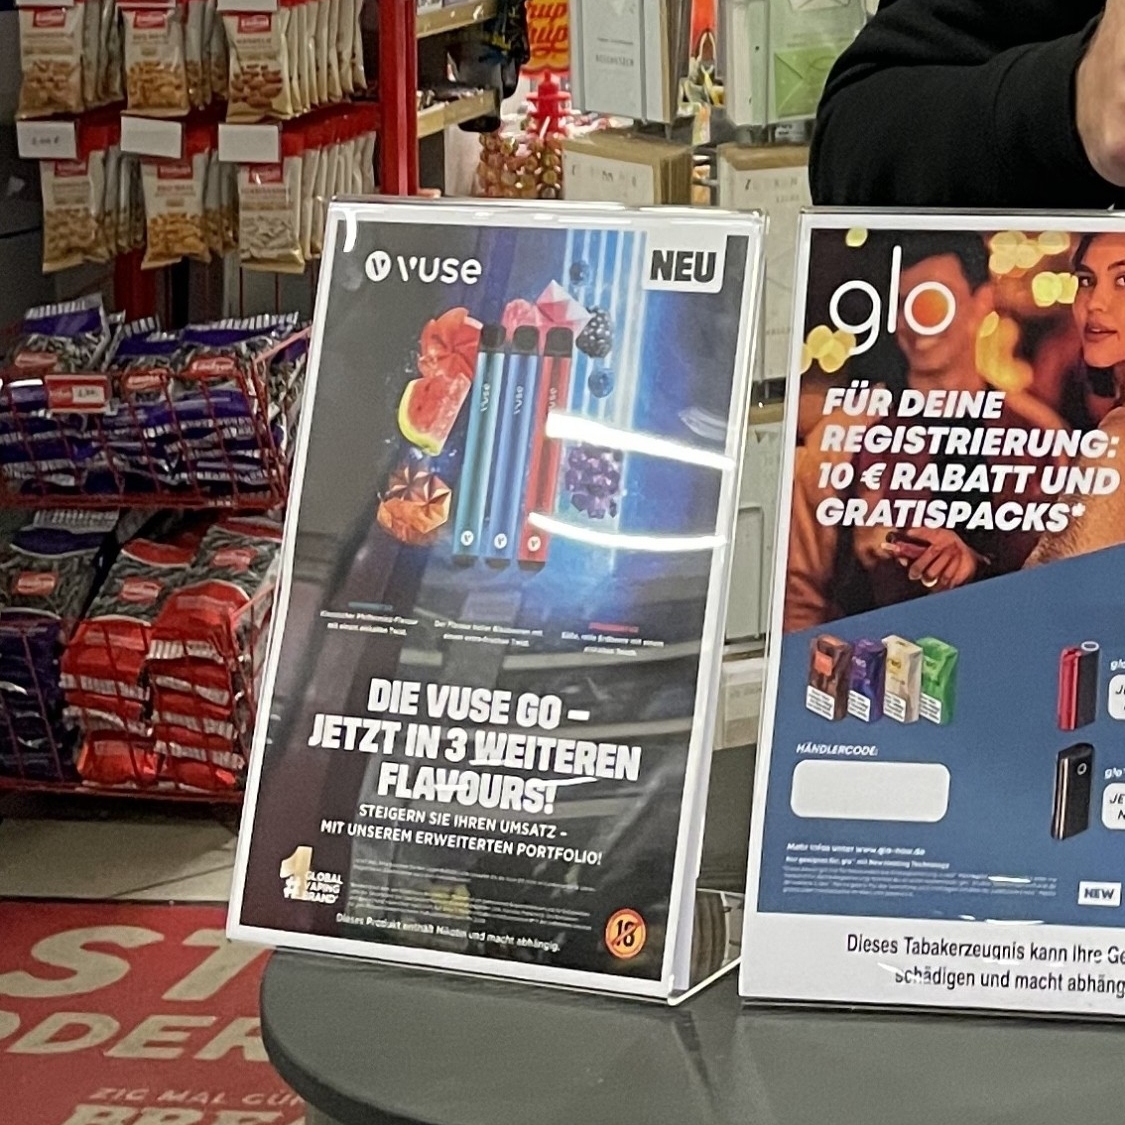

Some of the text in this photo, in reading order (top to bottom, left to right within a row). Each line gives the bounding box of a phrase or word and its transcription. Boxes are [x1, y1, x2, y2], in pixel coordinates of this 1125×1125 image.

[649, 248, 717, 283] NEU
[828, 245, 957, 356] glo
[822, 379, 1006, 420] FÜR DEINE
[820, 424, 1120, 459] REGISTRIERUNG:
[818, 461, 1122, 497] 10 € RABATT UND
[367, 677, 421, 715] DIE
[426, 683, 512, 724] VUSE
[516, 692, 563, 730] GO
[307, 713, 642, 782] JETZT IN 3 WEITEREN
[377, 761, 559, 815] FLAVOURS!
[359, 803, 427, 824] STEIGERN
[428, 811, 451, 826] SIE
[454, 814, 497, 832] IHREN
[500, 818, 557, 840] UMSATZ
[320, 819, 603, 866] MIT UNSEREM ERWEITERTEN PORTFOLIO!
[305, 871, 343, 885] GLOBAL
[1084, 888, 1115, 900] NEW
[335, 912, 364, 925] Dieses
[366, 916, 401, 929] Produkt
[468, 931, 486, 942] und
[487, 933, 515, 946] macht
[847, 933, 898, 955] Dieses
[904, 936, 1025, 962] Tabakerzeugnis
[1030, 942, 1068, 963] kann
[1073, 943, 1102, 964] Ihre
[980, 969, 1010, 989] und
[1015, 971, 1063, 991] macht
